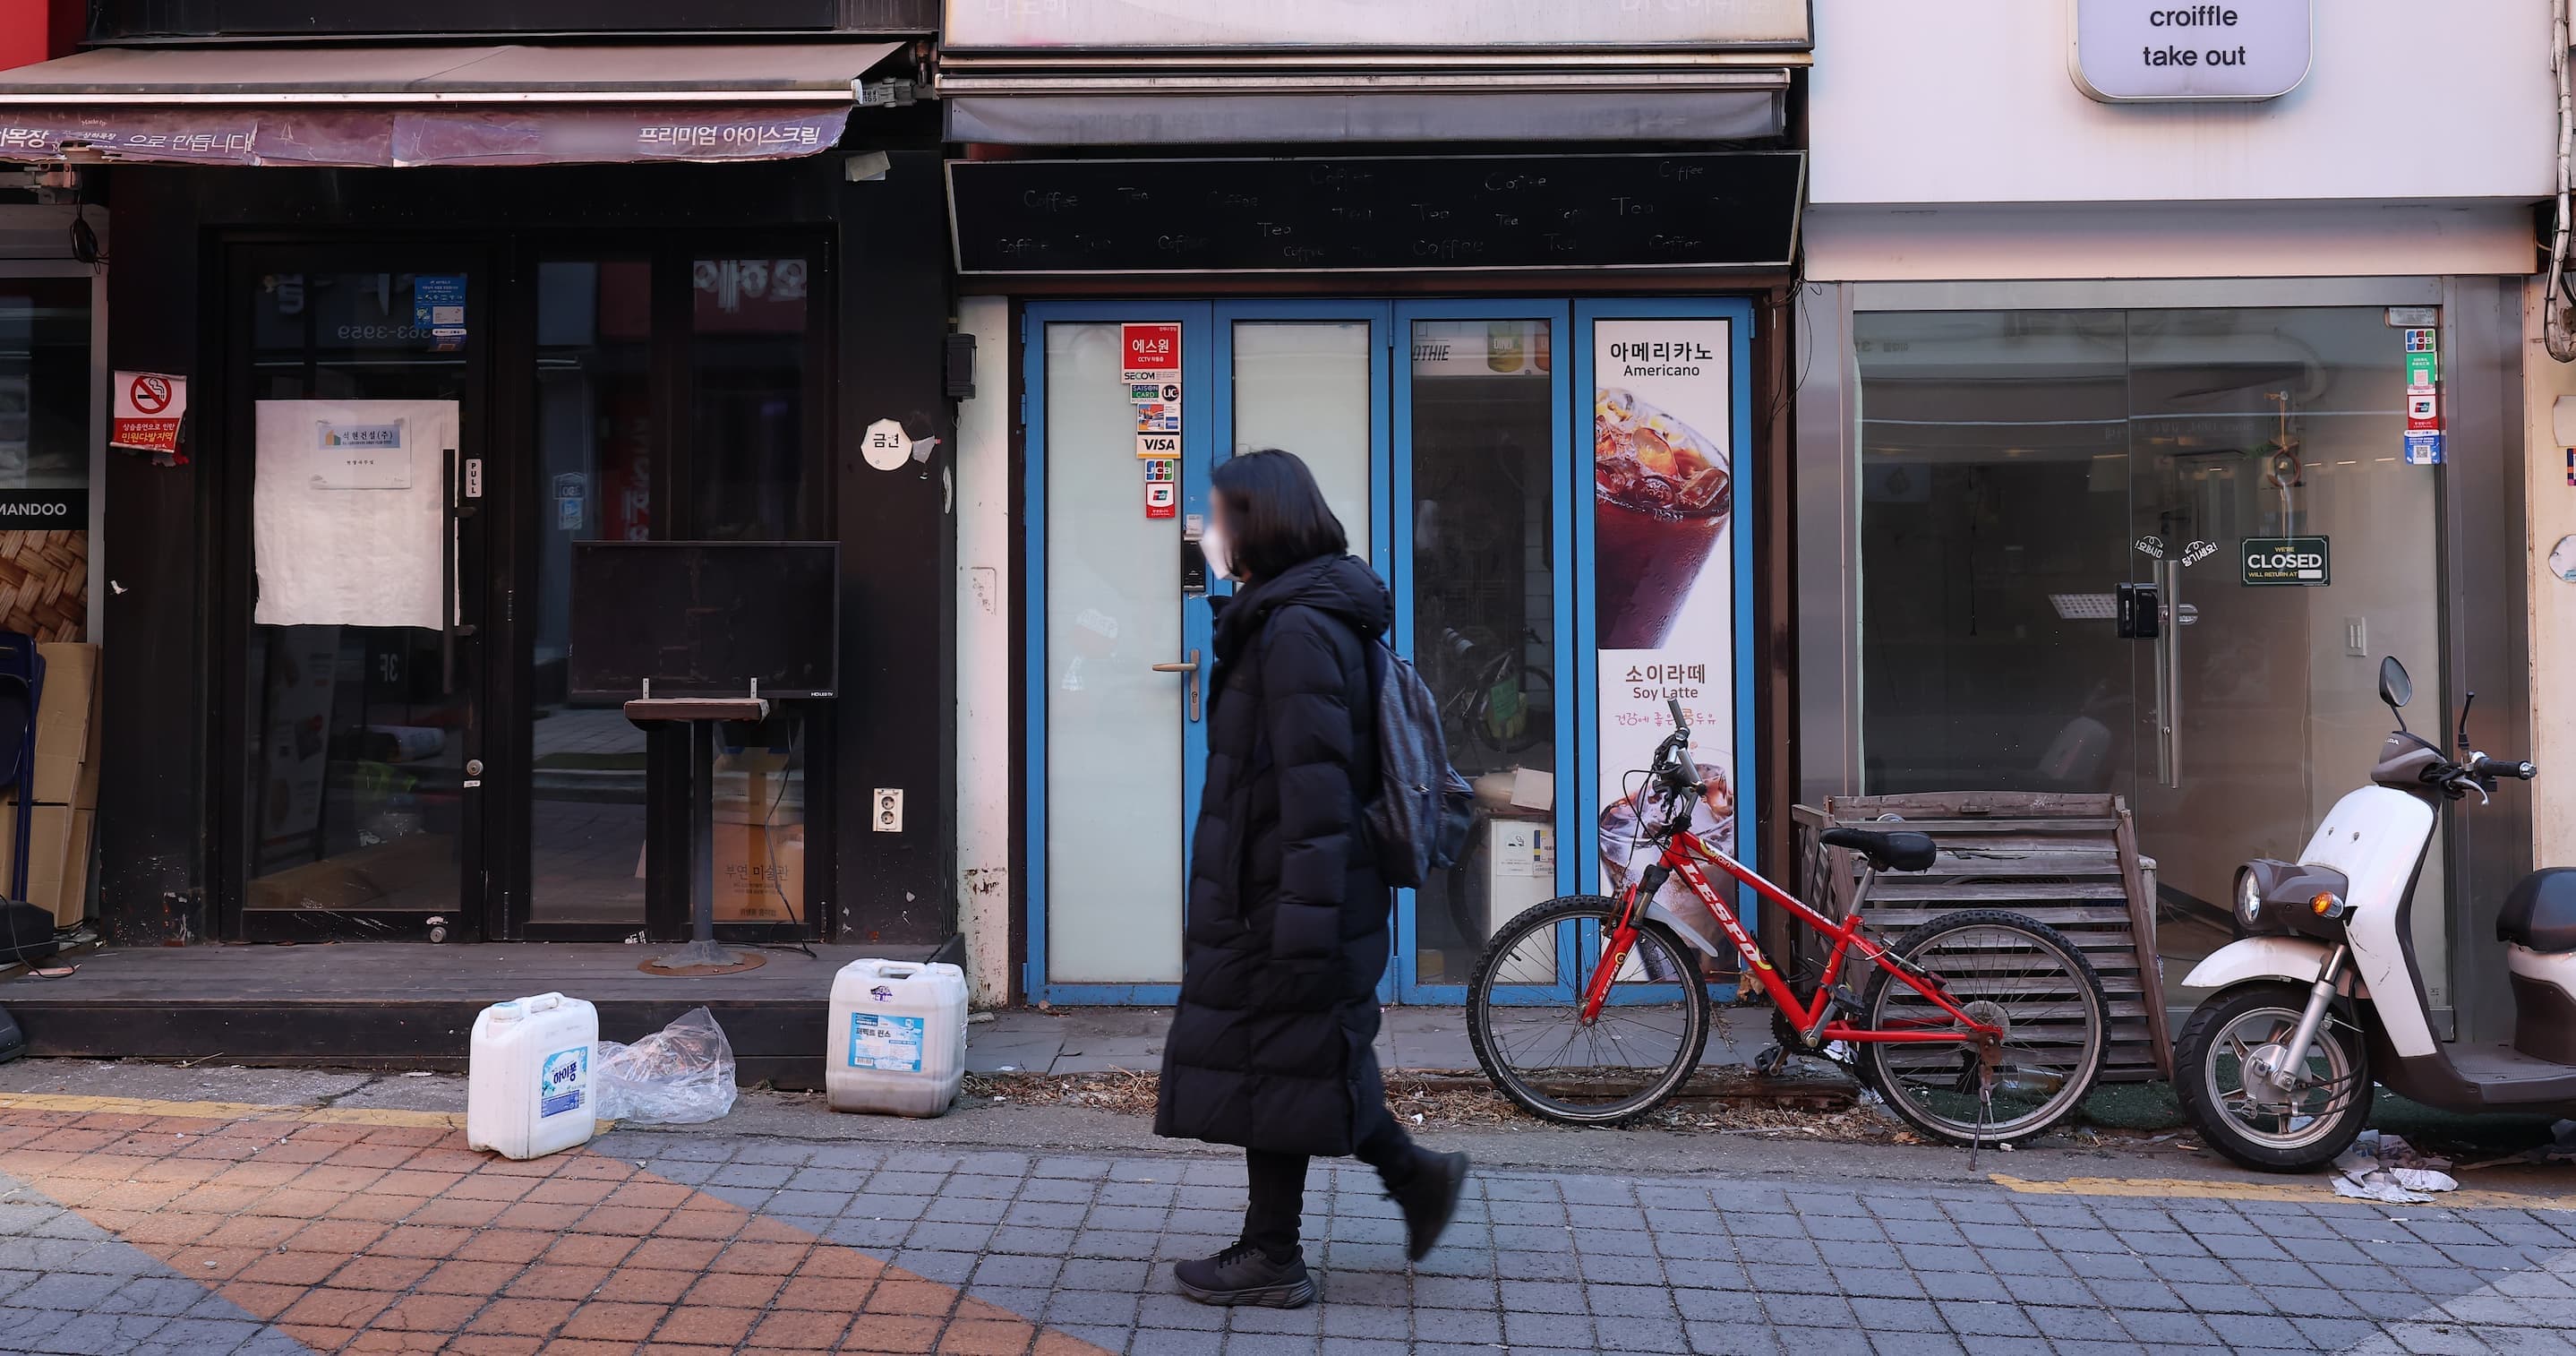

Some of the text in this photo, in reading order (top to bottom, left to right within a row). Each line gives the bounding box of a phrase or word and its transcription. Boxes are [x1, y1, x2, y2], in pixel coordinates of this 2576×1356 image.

[2150, 5, 2238, 27] croiffle
[2143, 45, 2246, 66] take out
[124, 133, 256, 153] 으로 만듭니다
[637, 126, 821, 146] 프리미엄 아이스크림
[1612, 196, 1655, 215] Tea
[1255, 222, 1291, 237] Tea
[1132, 339, 1169, 354] 에스원
[2407, 336, 2434, 345] JCB
[1610, 341, 1713, 363] 아메리카노
[1124, 372, 1155, 381] SECOM
[1623, 364, 1700, 376] Americano
[1163, 388, 1178, 399] UC
[121, 431, 174, 443] 민원다발지역
[1143, 439, 1175, 451] VISA
[1145, 466, 1172, 476] JCB
[2247, 554, 2323, 569] CLOSED
[1625, 664, 1706, 684] 소이라떼
[1633, 687, 1699, 701] Soy Latte
[1615, 712, 1649, 726] 건강에
[1655, 711, 1674, 726] 좋은
[724, 865, 789, 881] 부연 미술관
[1680, 863, 1760, 962] LESPO
[1598, 964, 1620, 1003] LESPO
